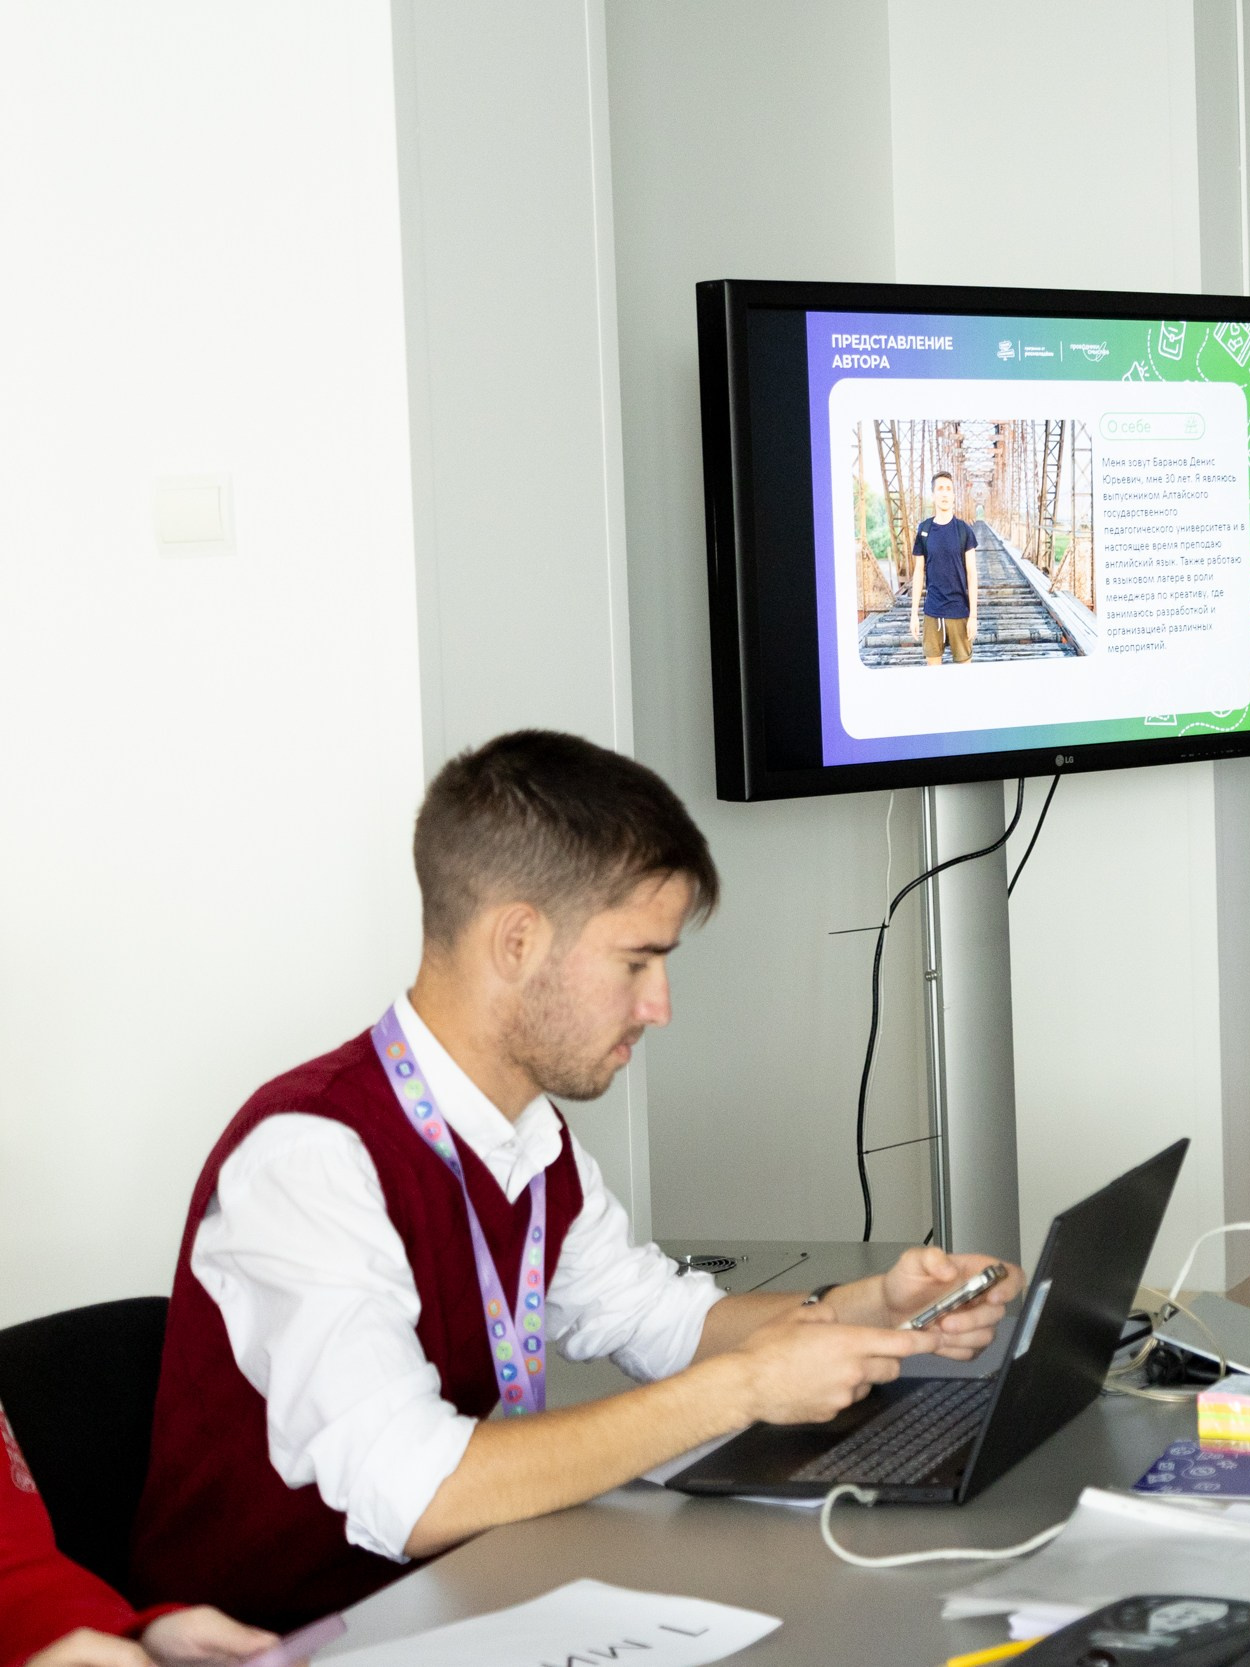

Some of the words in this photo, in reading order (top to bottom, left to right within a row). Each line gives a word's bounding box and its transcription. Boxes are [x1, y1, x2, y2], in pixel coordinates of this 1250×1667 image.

[831, 333, 954, 351] ПРЕДСТАВЛЕНИЕ
[832, 354, 890, 369] АВТОРА
[1107, 420, 1117, 433] О
[1121, 419, 1151, 433] себе
[1102, 457, 1126, 467] Меня
[1128, 458, 1151, 469] зовут
[1152, 457, 1188, 469] Баранов
[1189, 457, 1216, 467] Денис
[1102, 474, 1144, 485] Юрьевич,
[1146, 476, 1163, 484] мне
[1165, 473, 1176, 484] 30
[1177, 475, 1193, 483] лет.
[1195, 473, 1201, 483] Я
[1202, 474, 1237, 483] являюсь
[1103, 492, 1160, 502] выпускником
[1162, 490, 1209, 500] Алтайского
[1103, 508, 1178, 519] государственного
[1104, 525, 1174, 535] педагогического
[1176, 523, 1231, 534] университета
[1233, 523, 1239, 531] и
[1240, 523, 1246, 531] в
[1104, 543, 1150, 552] настоящее
[1152, 541, 1178, 551] время
[1180, 540, 1222, 550] преподаю
[1105, 557, 1153, 569] английский
[1155, 558, 1178, 568] язык.
[1180, 556, 1205, 566] Также
[1207, 555, 1242, 566] работаю
[1105, 577, 1110, 585] в
[1112, 575, 1155, 585] языковом
[1157, 574, 1184, 584] лагере
[1186, 573, 1192, 582] в
[1193, 573, 1214, 583] роли
[1106, 592, 1155, 603] менеджера
[1157, 591, 1167, 600] по
[1170, 590, 1208, 601] креативу,
[1211, 588, 1224, 598] где
[1106, 608, 1154, 619] занимаюсь
[1156, 605, 1208, 618] разработкой
[1210, 606, 1216, 614] и
[1107, 624, 1166, 638] организацией
[1168, 623, 1213, 635] различных
[1107, 640, 1167, 654] мероприятий.
